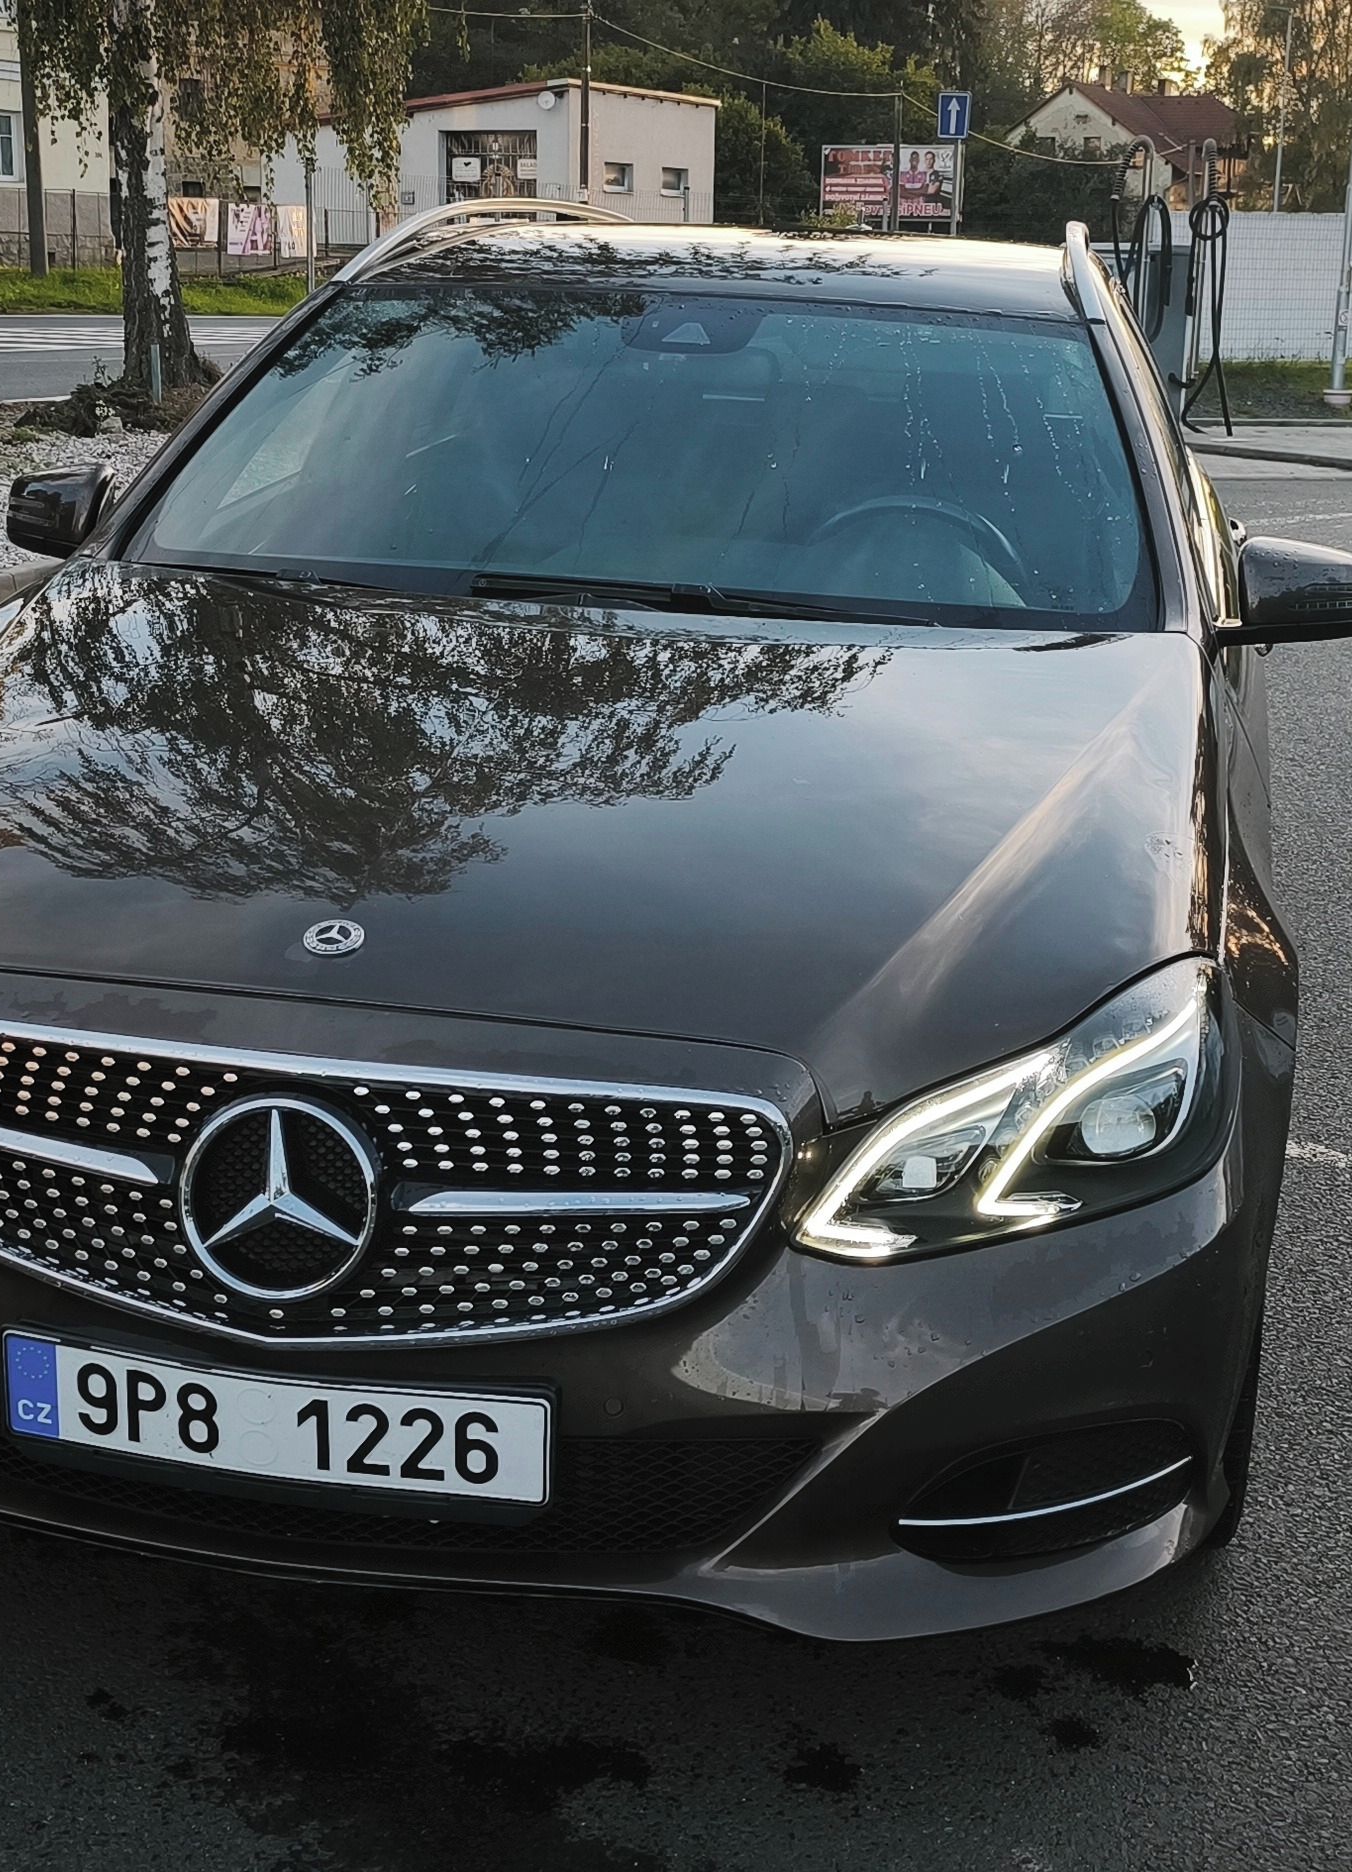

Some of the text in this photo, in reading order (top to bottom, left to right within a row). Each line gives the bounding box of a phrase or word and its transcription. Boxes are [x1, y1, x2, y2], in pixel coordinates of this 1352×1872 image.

[17, 1399, 53, 1425] CZ
[76, 1362, 500, 1485] 9P8 1226
